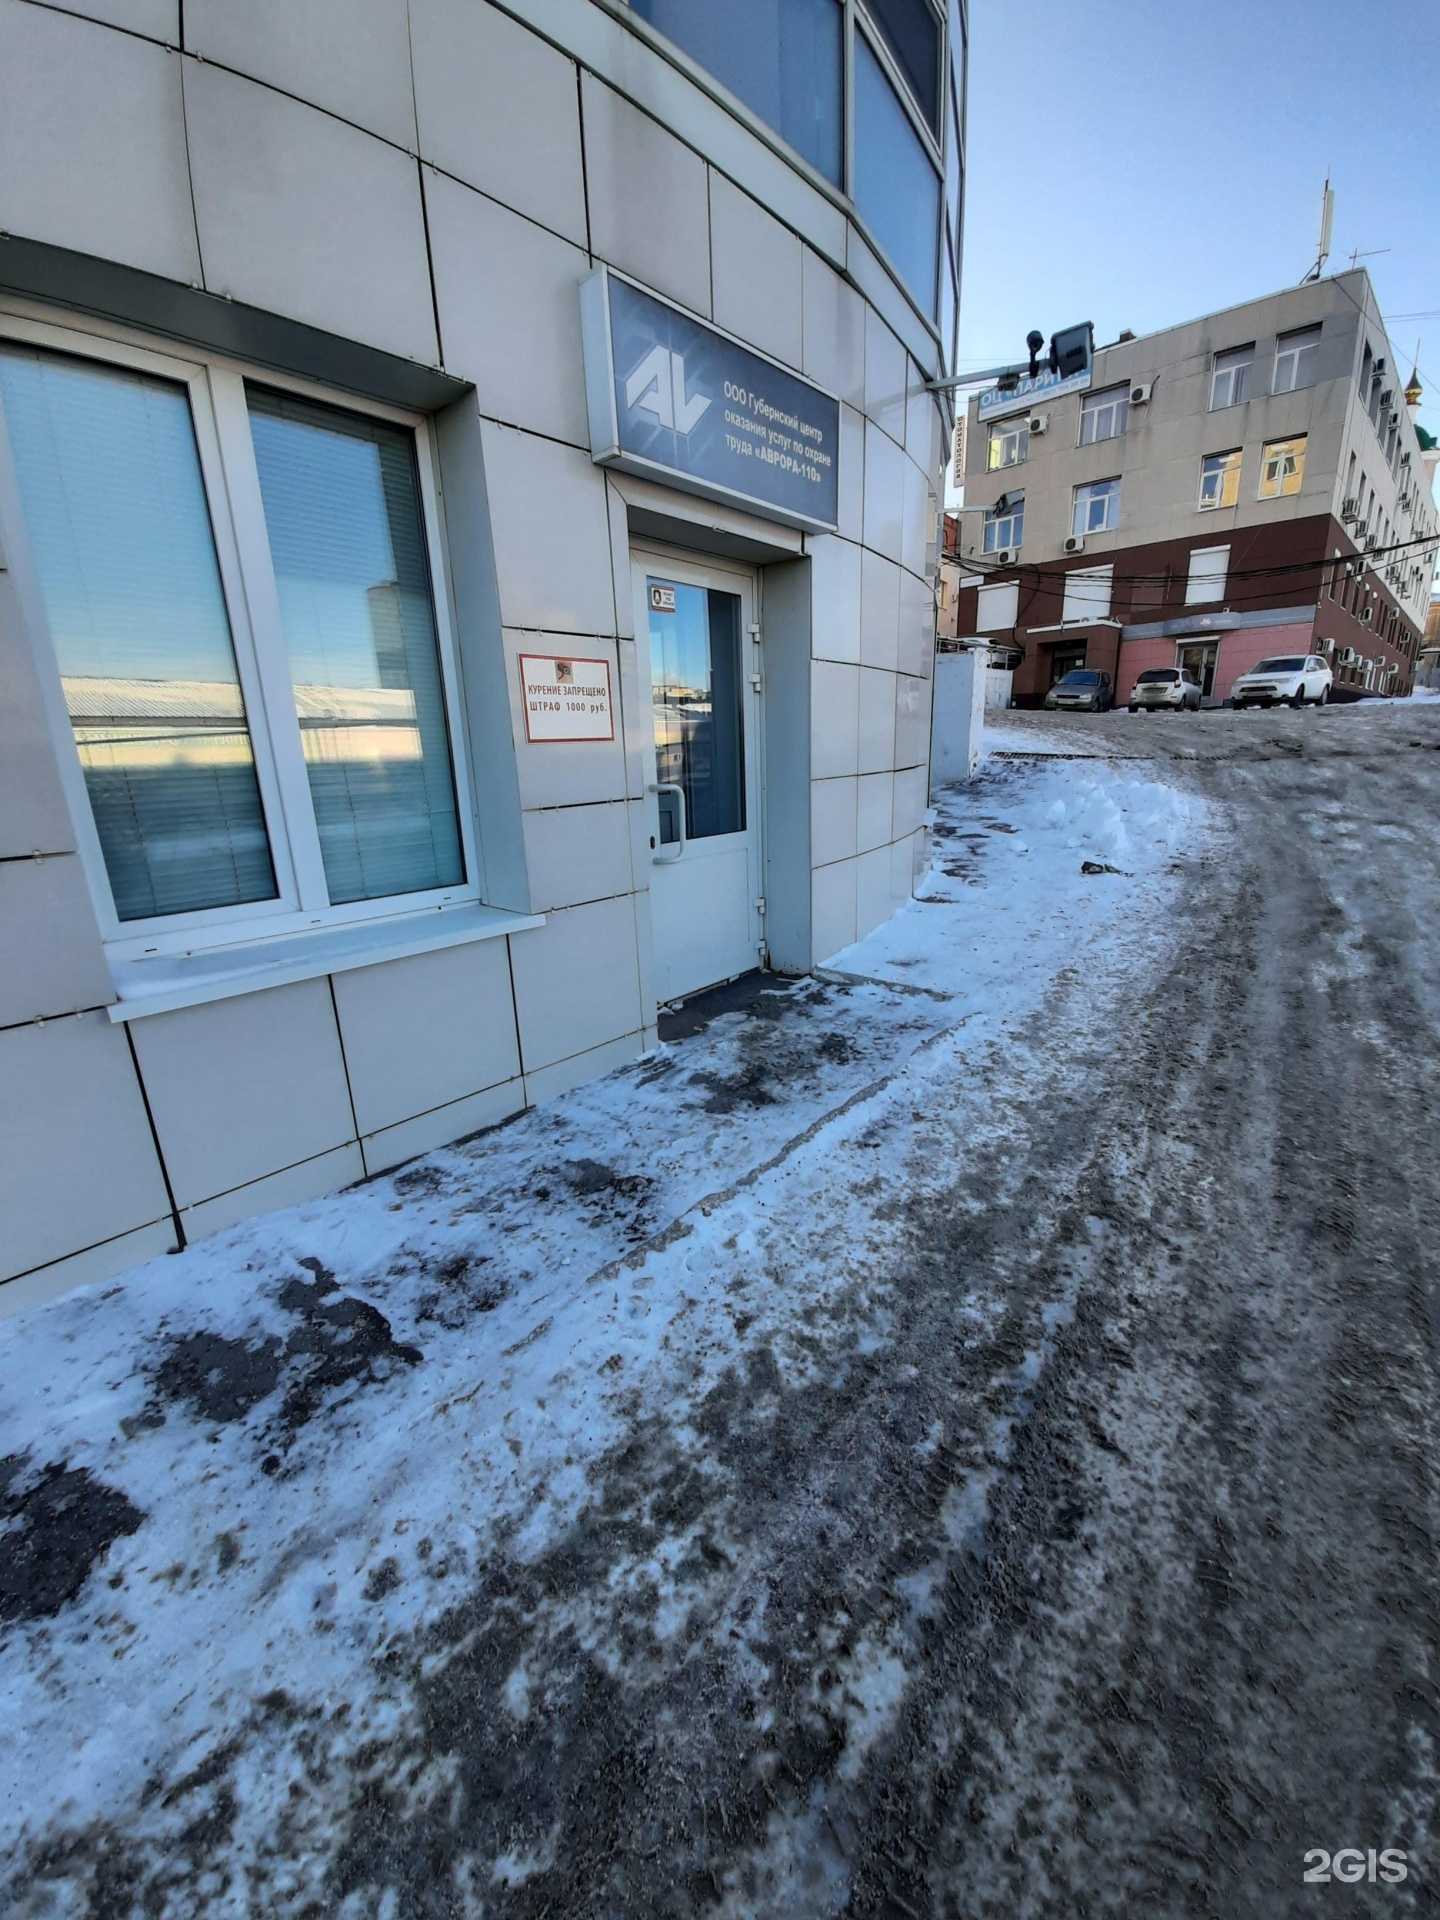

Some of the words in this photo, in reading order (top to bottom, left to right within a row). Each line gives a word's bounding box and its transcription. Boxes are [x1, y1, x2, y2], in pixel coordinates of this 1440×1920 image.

[724, 381, 746, 405] ООО
[748, 392, 799, 430] Губернский
[799, 422, 822, 444] центр
[725, 409, 767, 439] оказания
[768, 429, 791, 451] услуг
[793, 441, 803, 454] по
[804, 447, 832, 466] охране
[725, 434, 752, 456] труда
[755, 445, 821, 482] «АВРОРА-110»
[528, 684, 562, 696] КУРЕНИЕ
[563, 685, 606, 697] ЗАПРЕЩЕНО
[530, 701, 561, 712] ШТРАФ
[566, 702, 586, 712] 1000
[590, 702, 608, 713] руб.
